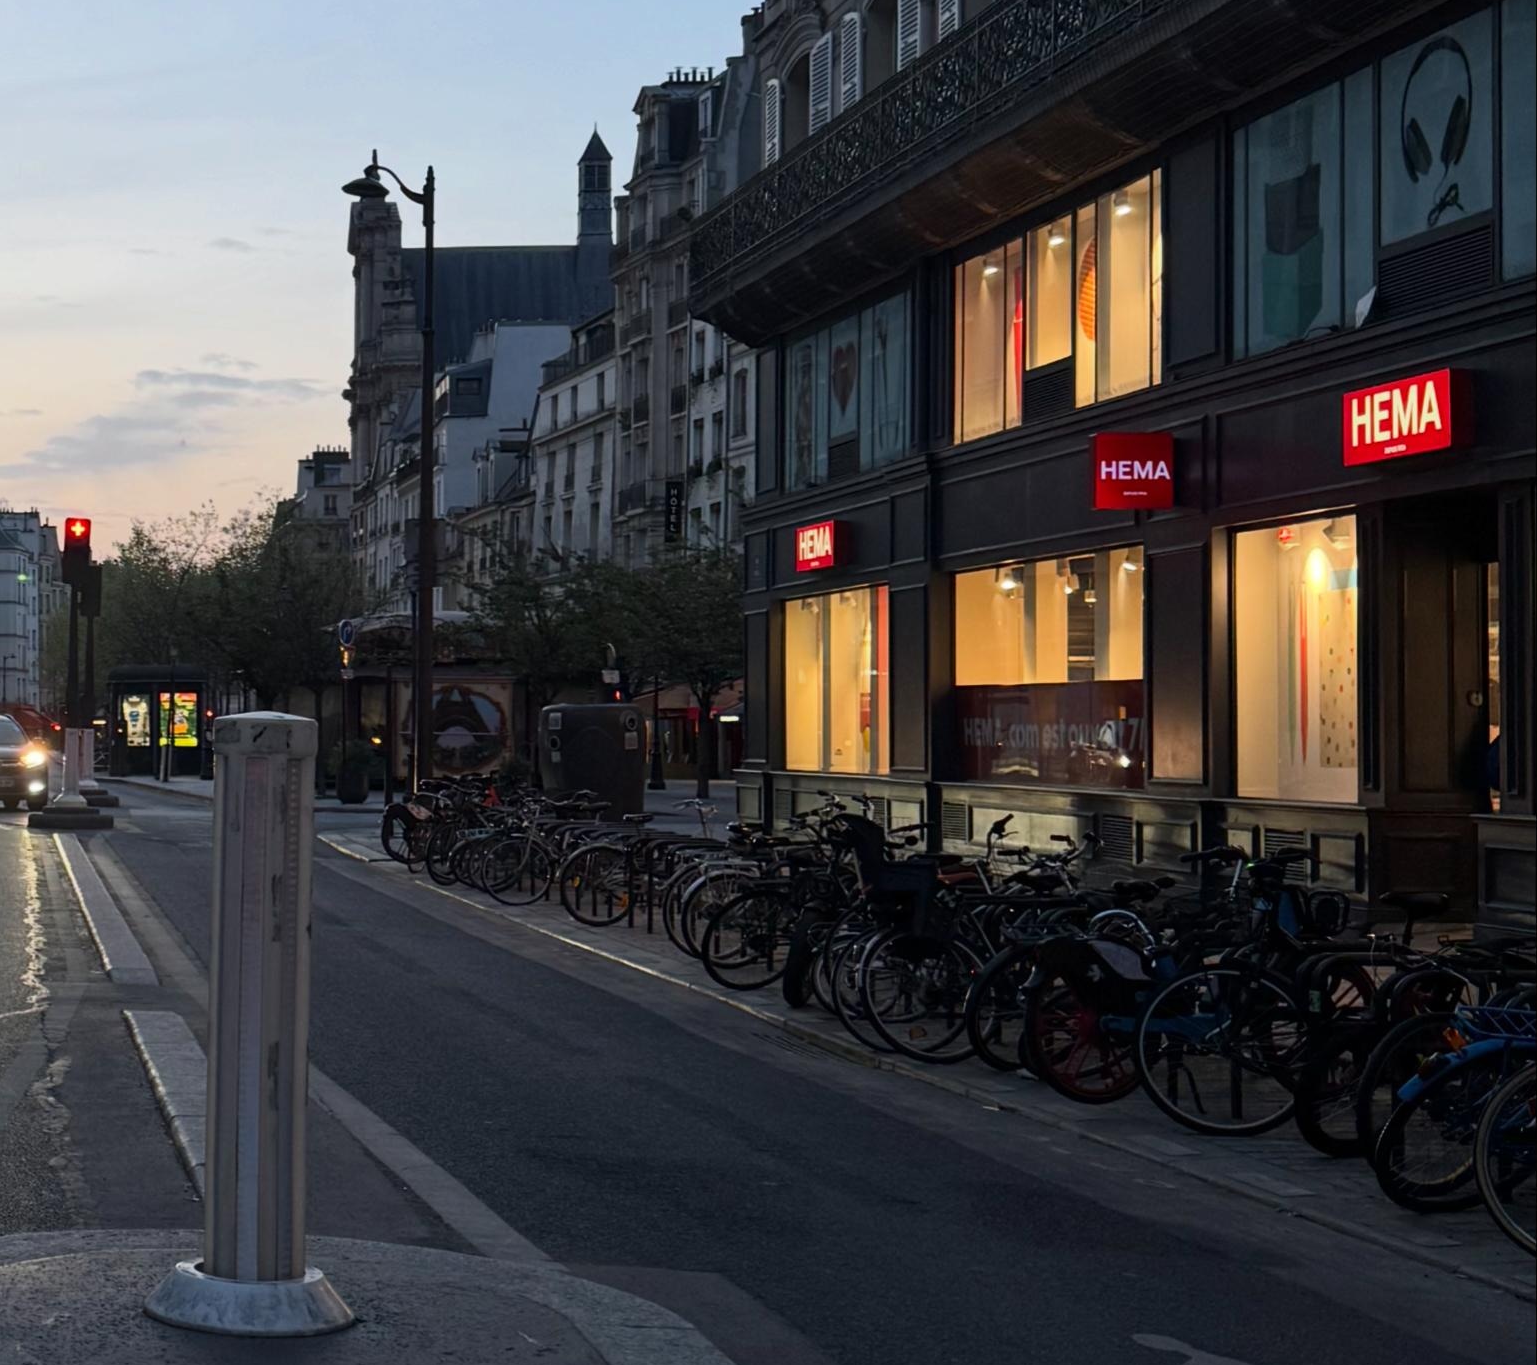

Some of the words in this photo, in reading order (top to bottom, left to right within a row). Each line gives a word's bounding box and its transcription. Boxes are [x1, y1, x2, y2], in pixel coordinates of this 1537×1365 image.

[1352, 380, 1442, 447] HEMA
[1100, 460, 1171, 480] HEMA
[799, 525, 832, 561] HEMA
